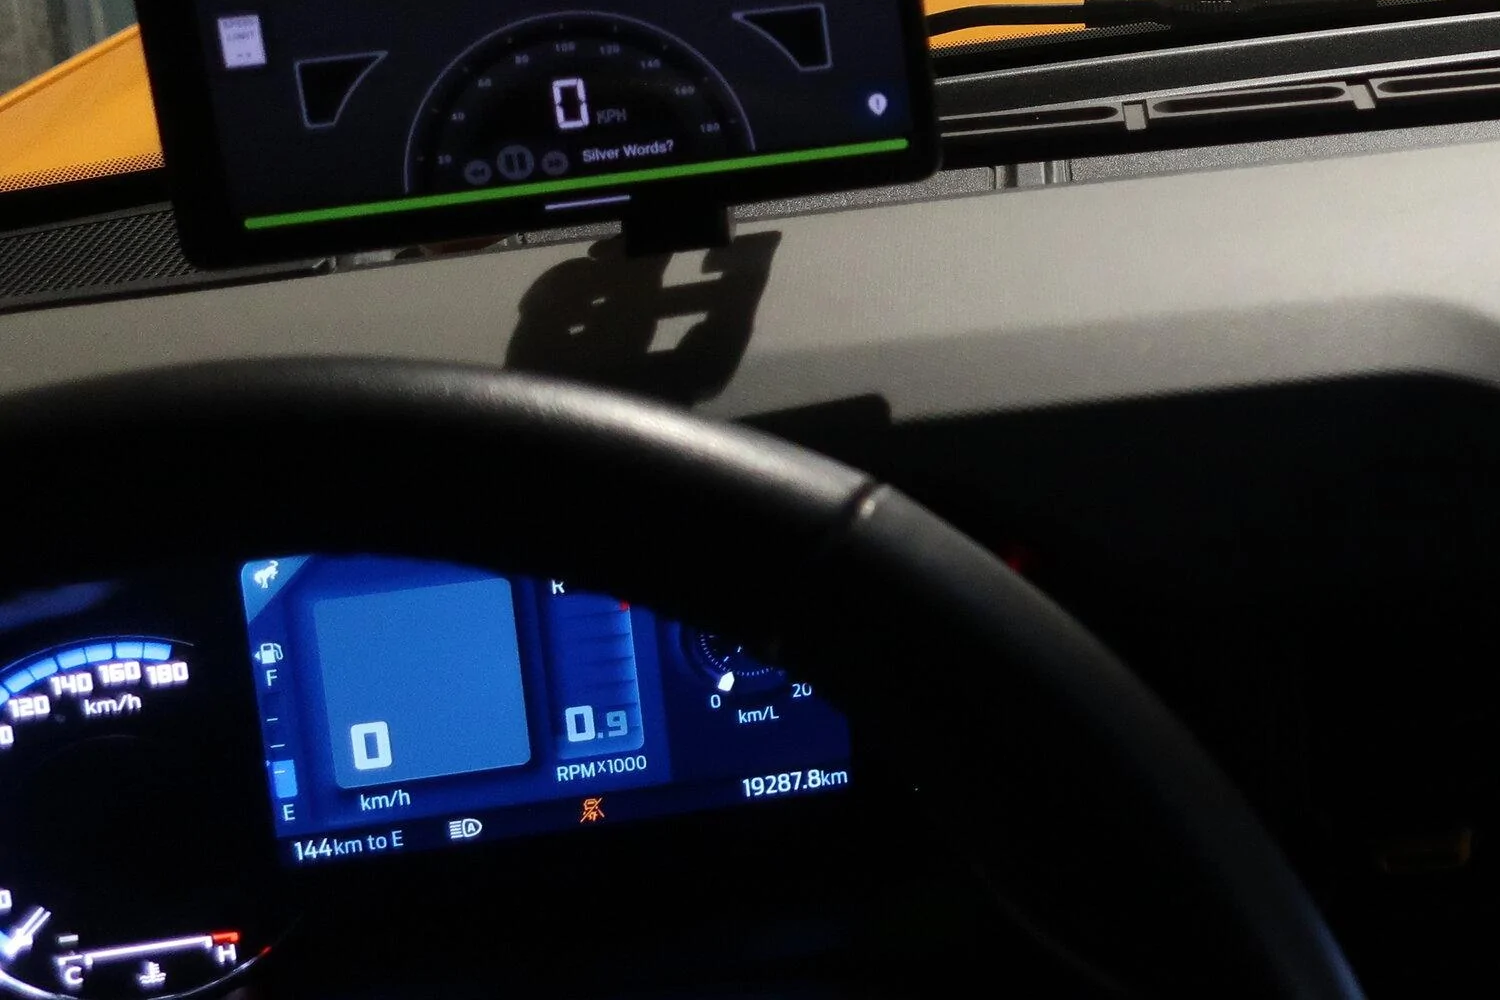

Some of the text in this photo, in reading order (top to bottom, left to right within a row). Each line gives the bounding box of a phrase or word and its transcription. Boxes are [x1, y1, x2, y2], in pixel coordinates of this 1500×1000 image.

[551, 78, 590, 130] 0
[596, 107, 627, 124] KPH
[583, 139, 674, 163] Silver Words?
[98, 660, 142, 684] 160
[146, 661, 190, 686] 180
[266, 669, 278, 687] F
[50, 672, 94, 696] 140
[792, 683, 812, 698] 20
[8, 694, 51, 719] 120
[84, 693, 142, 715] km/h
[710, 694, 722, 708] 0
[565, 704, 629, 743] 0.9
[738, 705, 780, 724] km/L
[350, 720, 393, 771] 0
[742, 769, 848, 797] 19287.8km
[360, 789, 411, 811] km/h
[283, 803, 295, 821] E
[368, 834, 387, 851] to
[392, 829, 404, 847] E
[218, 944, 238, 963] H
[65, 966, 85, 985] C
